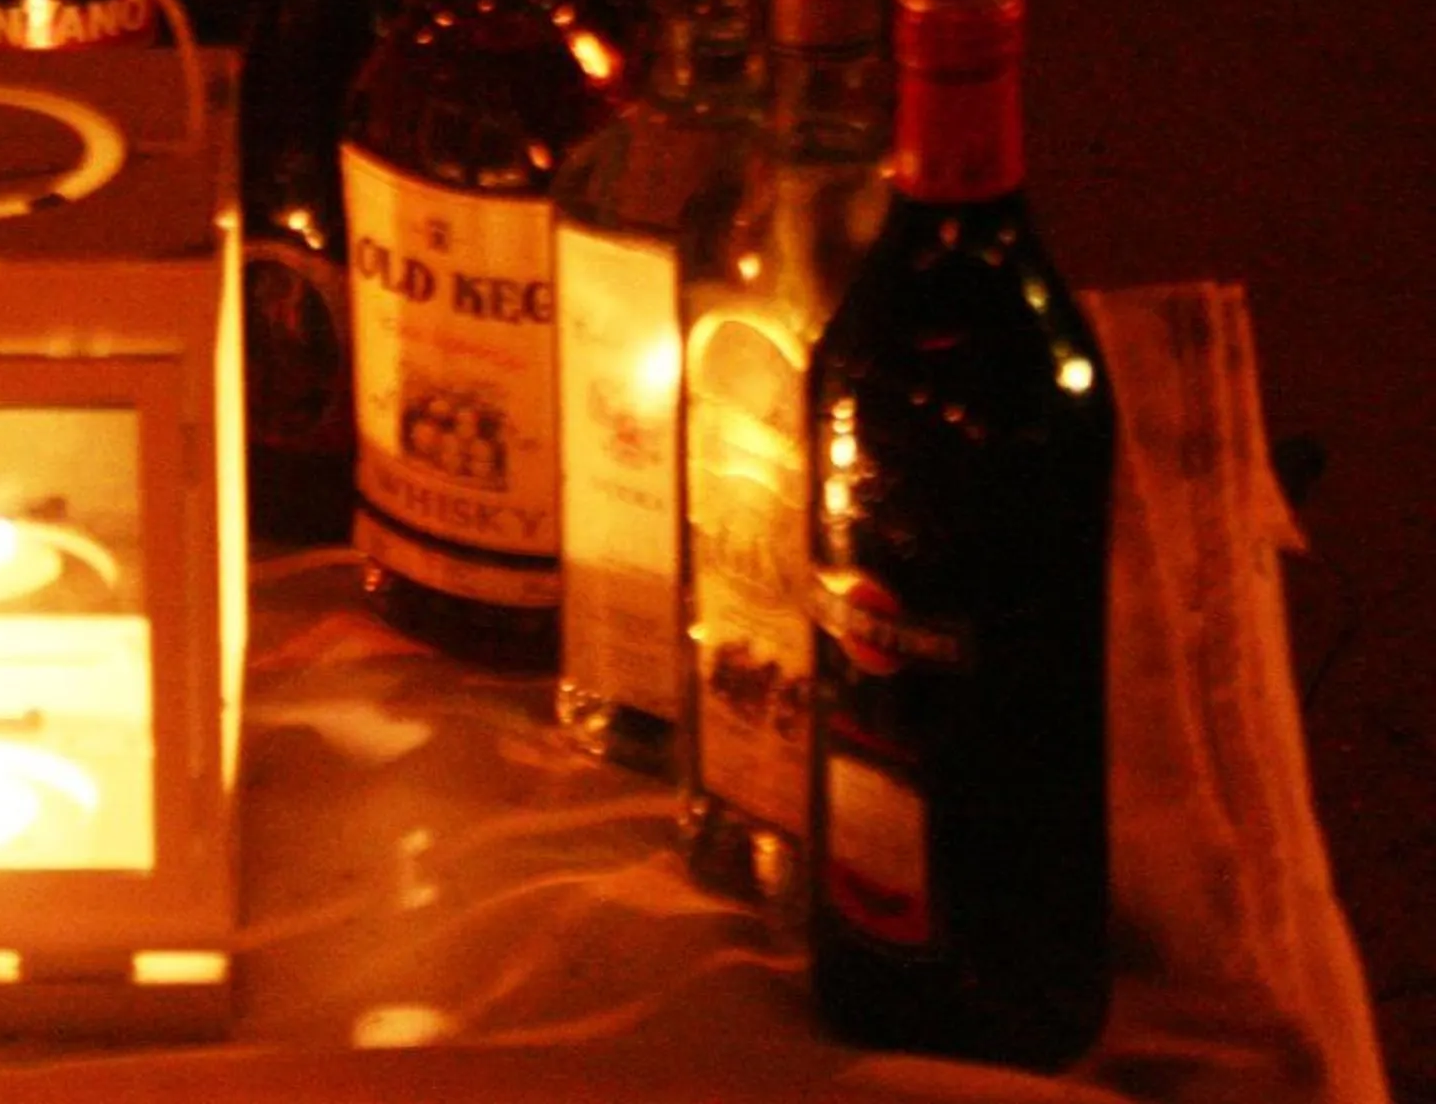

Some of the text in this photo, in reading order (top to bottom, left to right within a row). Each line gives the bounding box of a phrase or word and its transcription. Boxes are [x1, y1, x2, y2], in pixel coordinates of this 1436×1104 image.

[356, 236, 552, 326] OLD KEG
[376, 469, 549, 538] WHISKY
